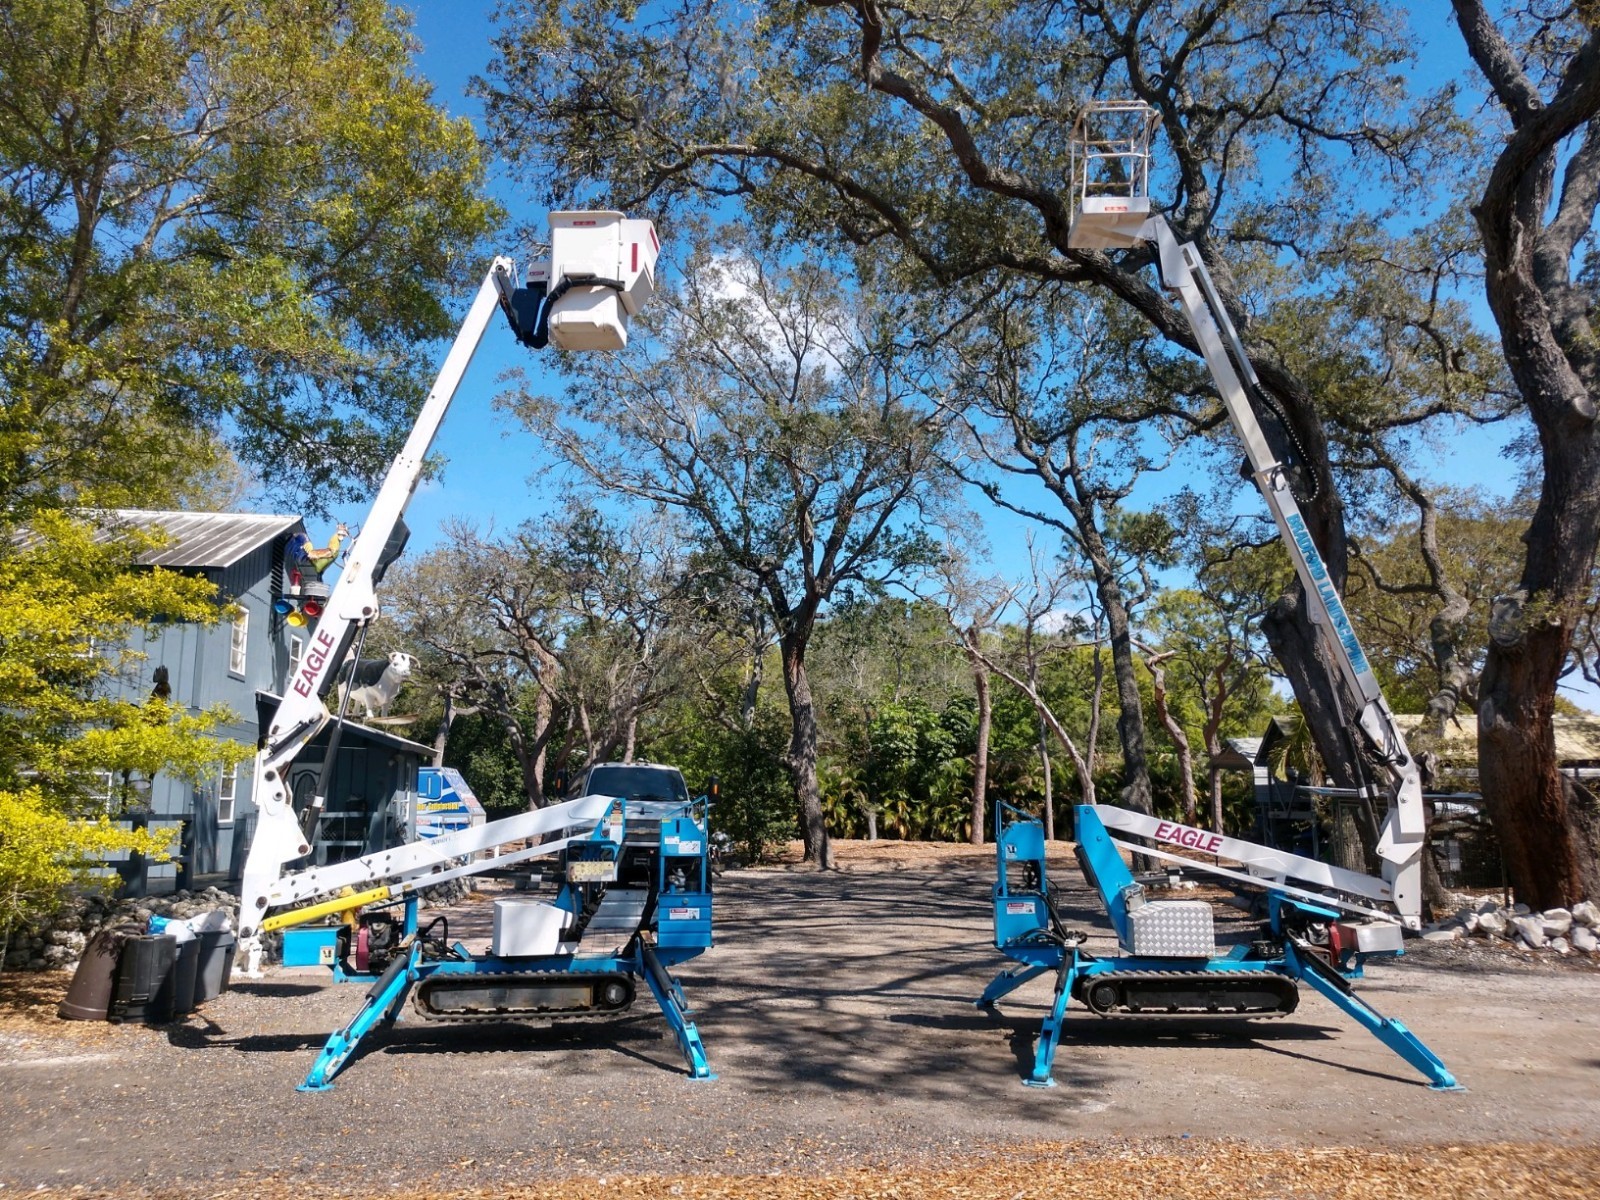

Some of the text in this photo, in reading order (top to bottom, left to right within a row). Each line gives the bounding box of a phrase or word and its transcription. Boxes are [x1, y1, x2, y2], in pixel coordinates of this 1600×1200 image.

[1286, 513, 1369, 675] BRADFORD LANDSCAPING
[294, 629, 335, 698] EAGLE
[1154, 822, 1224, 853] EAGLE
